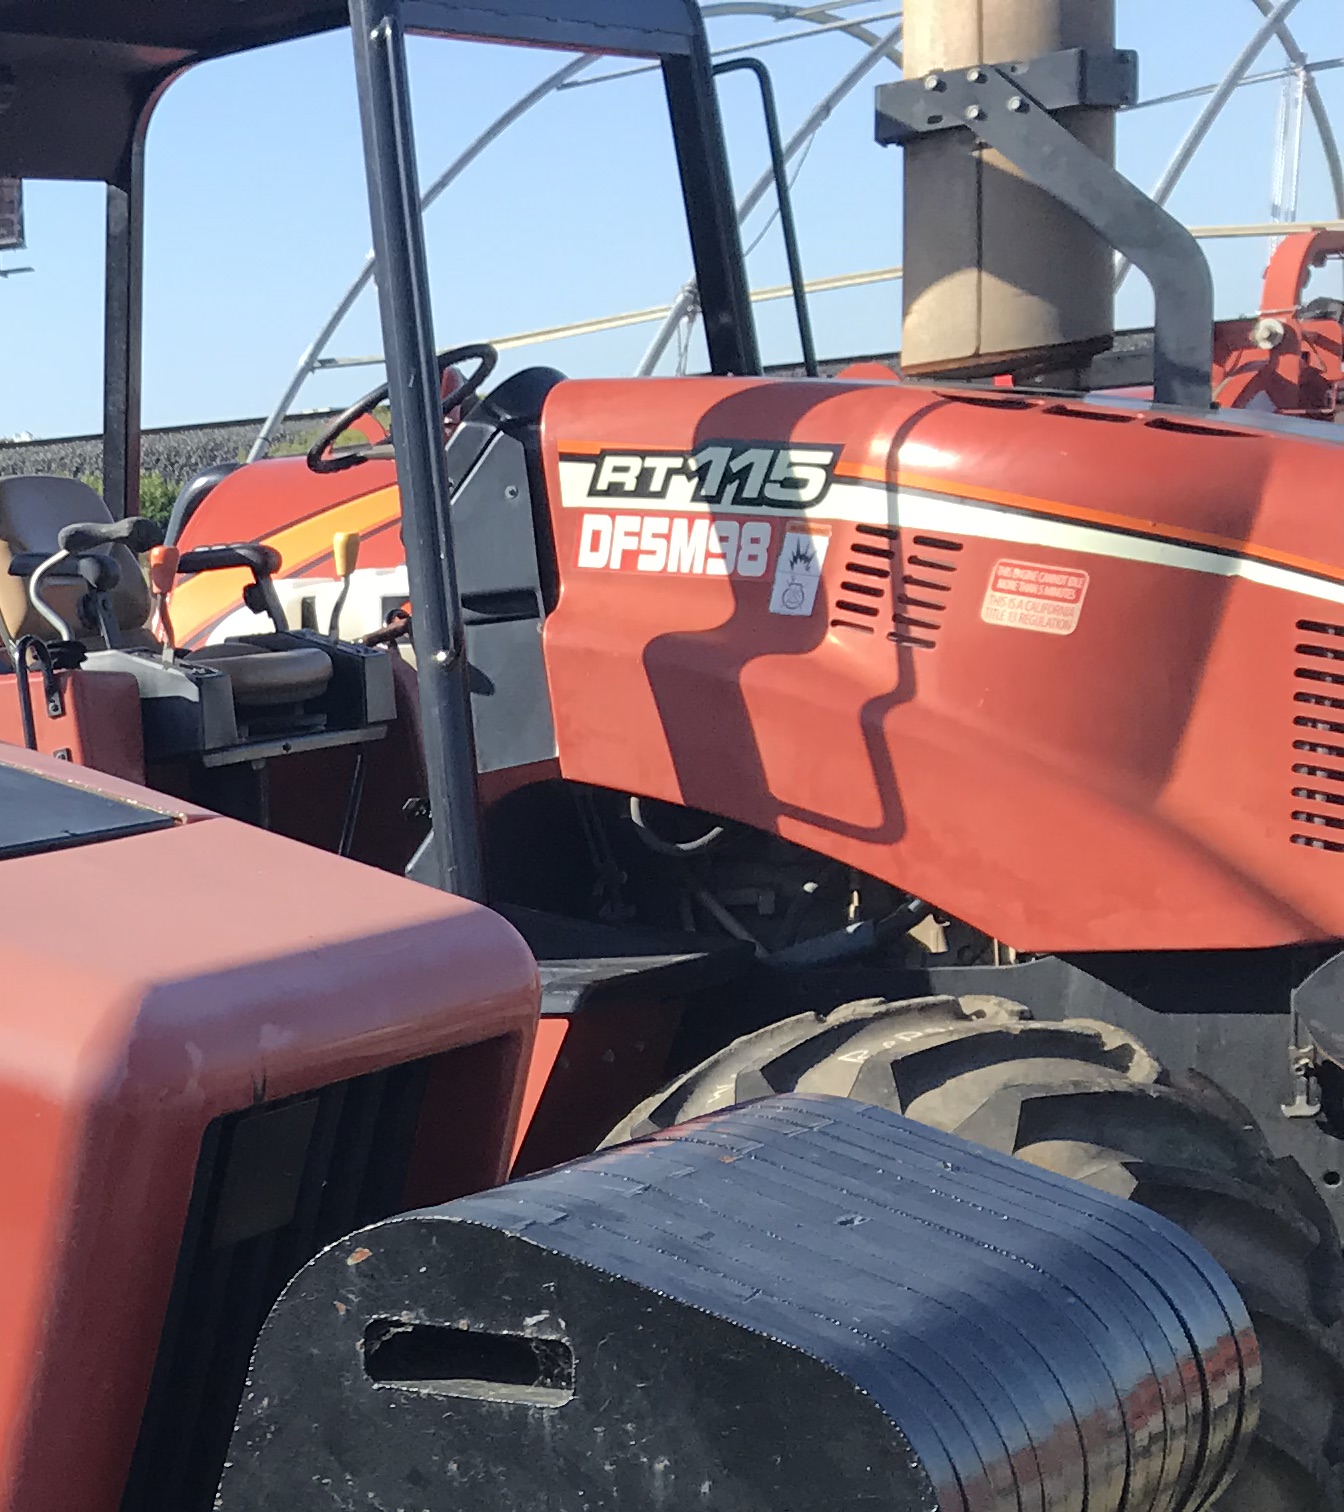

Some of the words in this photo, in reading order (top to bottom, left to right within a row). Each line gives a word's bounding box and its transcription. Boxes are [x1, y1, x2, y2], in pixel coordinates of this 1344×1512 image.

[596, 446, 833, 500] RT115
[986, 607, 1009, 621] TITLE
[1018, 612, 1073, 632] REGULATION
[1024, 600, 1076, 618] CALIFORNIA
